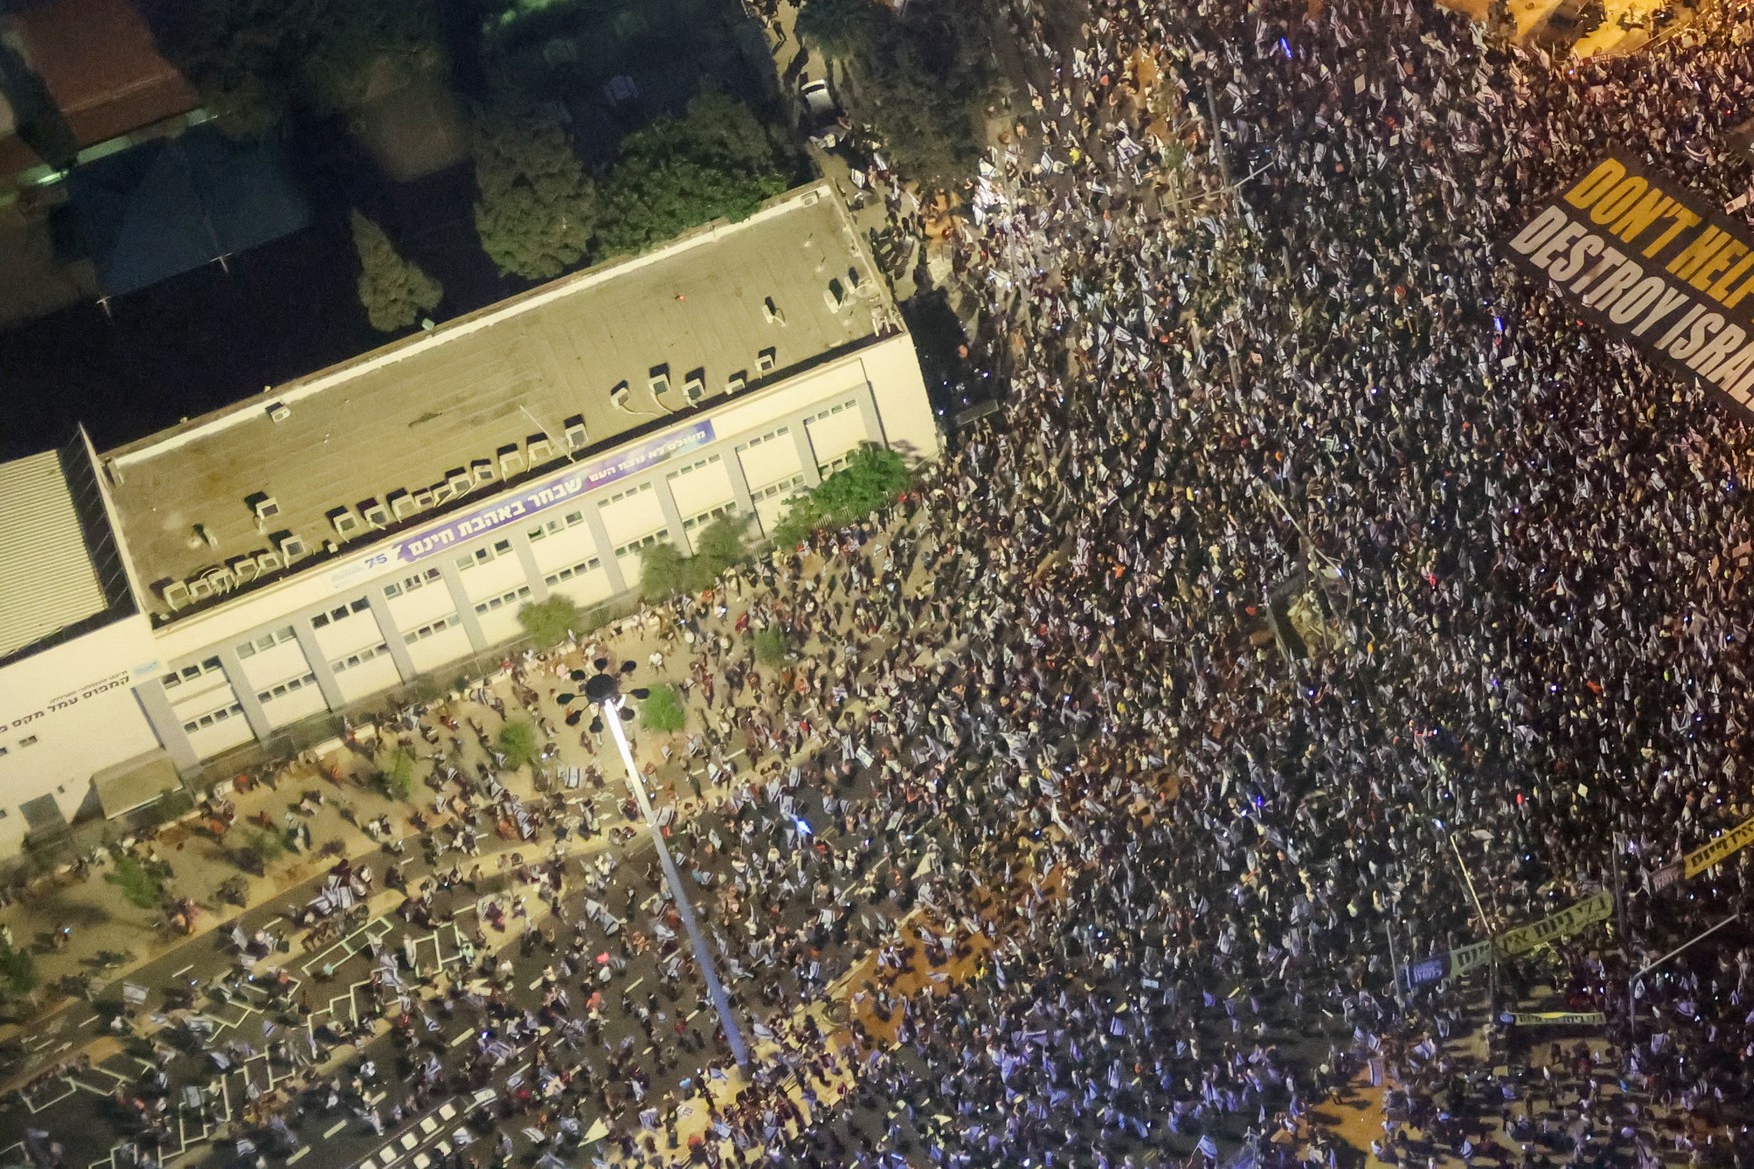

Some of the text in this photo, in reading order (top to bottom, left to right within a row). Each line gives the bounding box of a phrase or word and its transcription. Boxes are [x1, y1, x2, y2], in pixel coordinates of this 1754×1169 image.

[1562, 157, 1703, 260] DON'T
[1509, 204, 1690, 337] DESTROY
[527, 477, 583, 508] שבחר
[456, 499, 527, 538] באהבת
[407, 528, 456, 557] חינם
[82, 675, 130, 700] קמפוס
[11, 710, 45, 728] מקס
[46, 696, 79, 713] עמל
